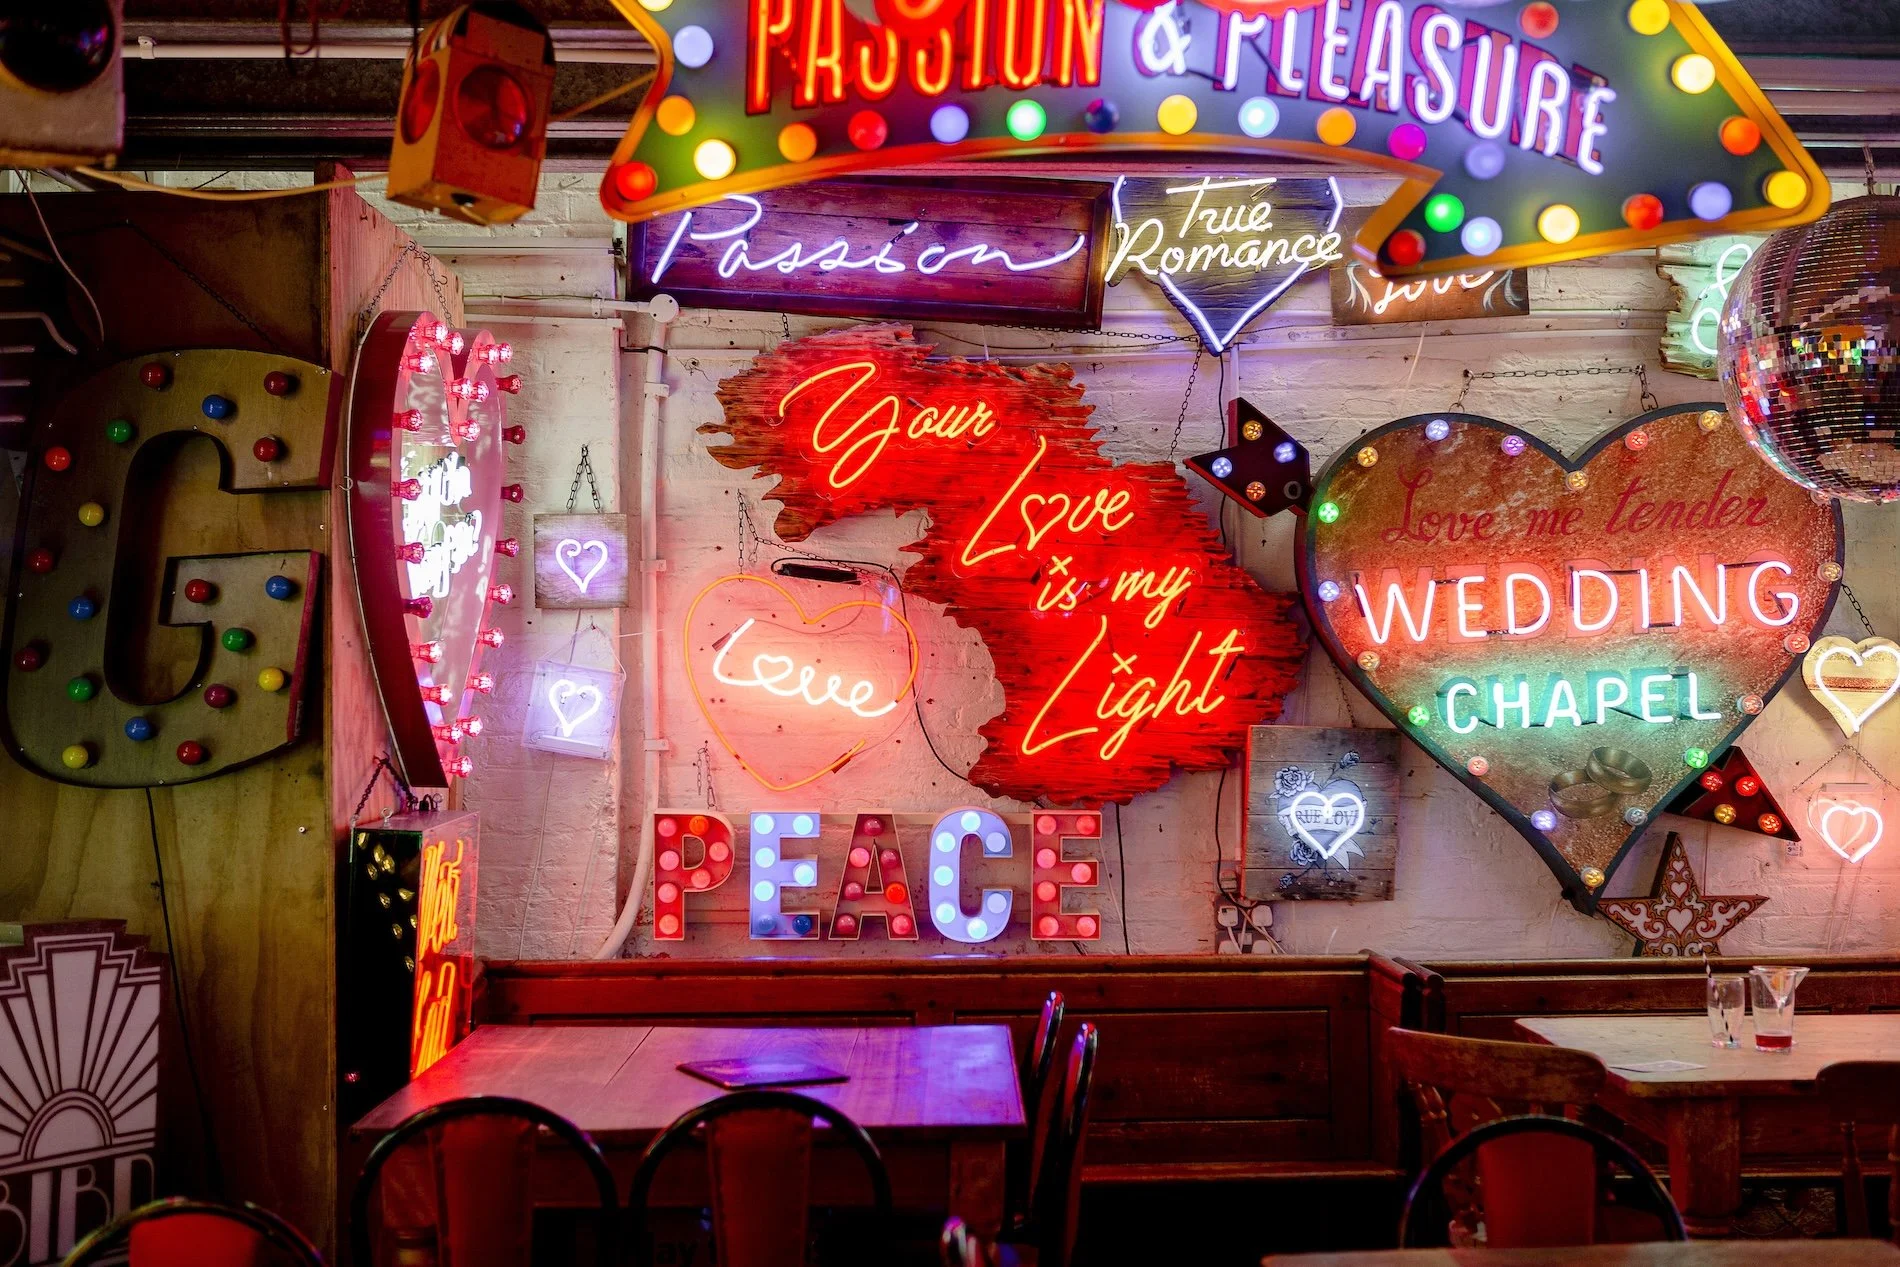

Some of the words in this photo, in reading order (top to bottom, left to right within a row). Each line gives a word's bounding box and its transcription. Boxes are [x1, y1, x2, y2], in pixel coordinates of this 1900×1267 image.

[650, 193, 1085, 284] Passion
[1103, 218, 1343, 283] Romance
[1165, 175, 1278, 239] True
[779, 361, 996, 489] Your
[960, 434, 1134, 566] Love
[1380, 466, 1496, 544] Love
[1525, 504, 1585, 538] me
[1604, 468, 1771, 535] tender
[1036, 555, 1078, 613] is
[1111, 565, 1192, 629] my
[1352, 558, 1801, 645] WEDDING
[712, 618, 898, 718] Love
[1021, 615, 1245, 761] Light
[1442, 668, 1723, 735] CHAPEL
[653, 806, 1103, 944] PEACE
